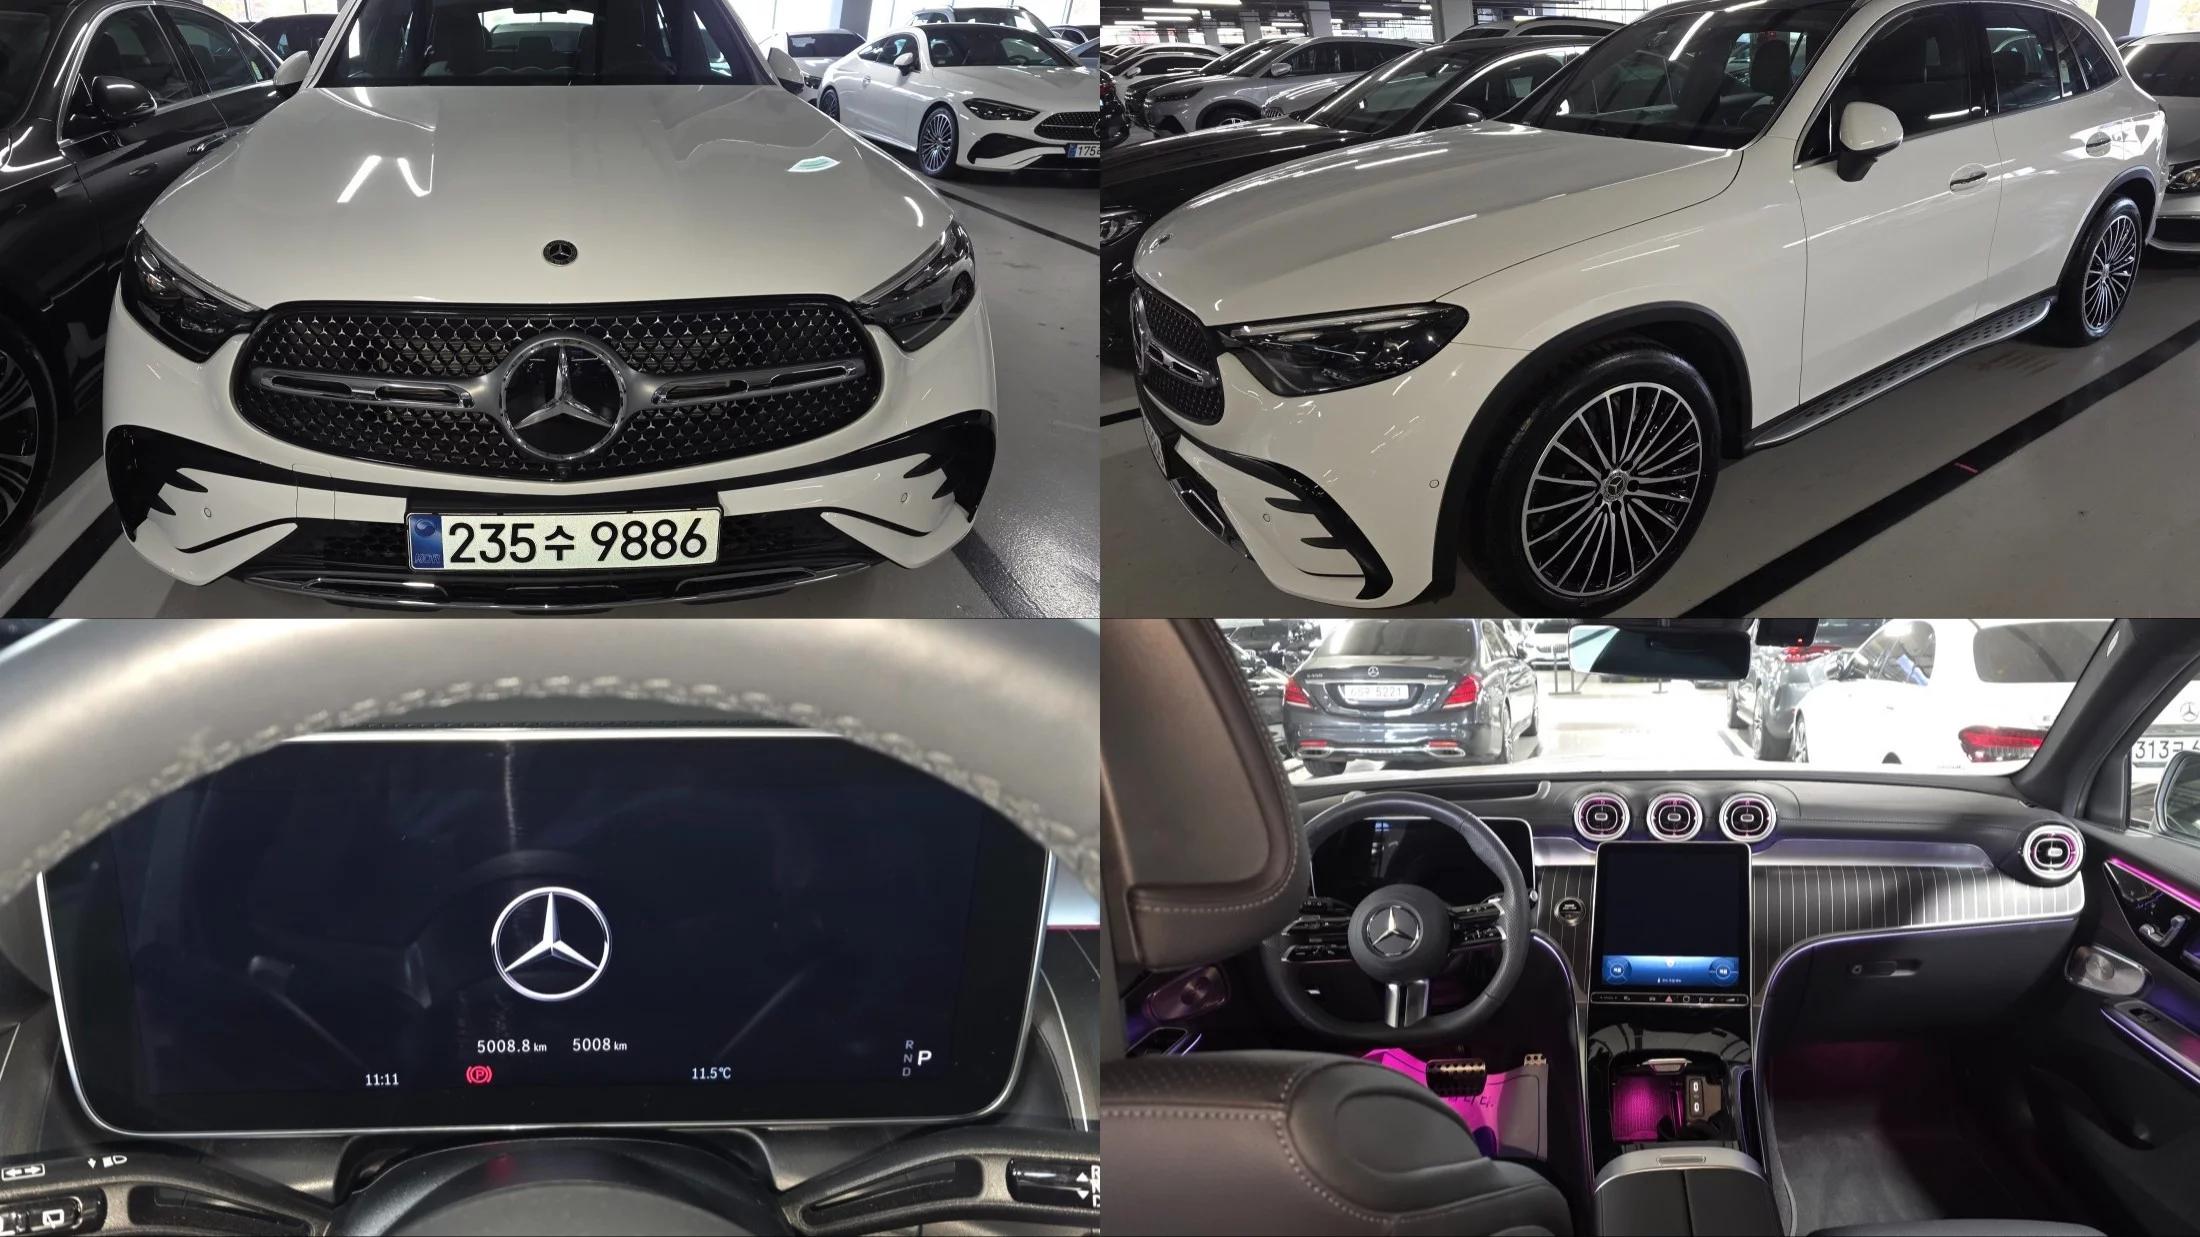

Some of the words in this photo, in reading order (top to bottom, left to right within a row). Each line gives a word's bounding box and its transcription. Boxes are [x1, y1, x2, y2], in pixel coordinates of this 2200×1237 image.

[449, 522, 575, 563] 235수
[591, 517, 707, 561] 9886
[477, 1039, 530, 1053] 5008.8
[533, 1042, 547, 1053] km
[572, 1037, 611, 1051] 5008
[614, 1041, 628, 1051] km
[905, 1040, 914, 1050] R
[903, 1054, 913, 1063] N
[917, 1050, 932, 1066] P
[902, 1067, 911, 1077] D
[365, 1073, 399, 1086] 11:11
